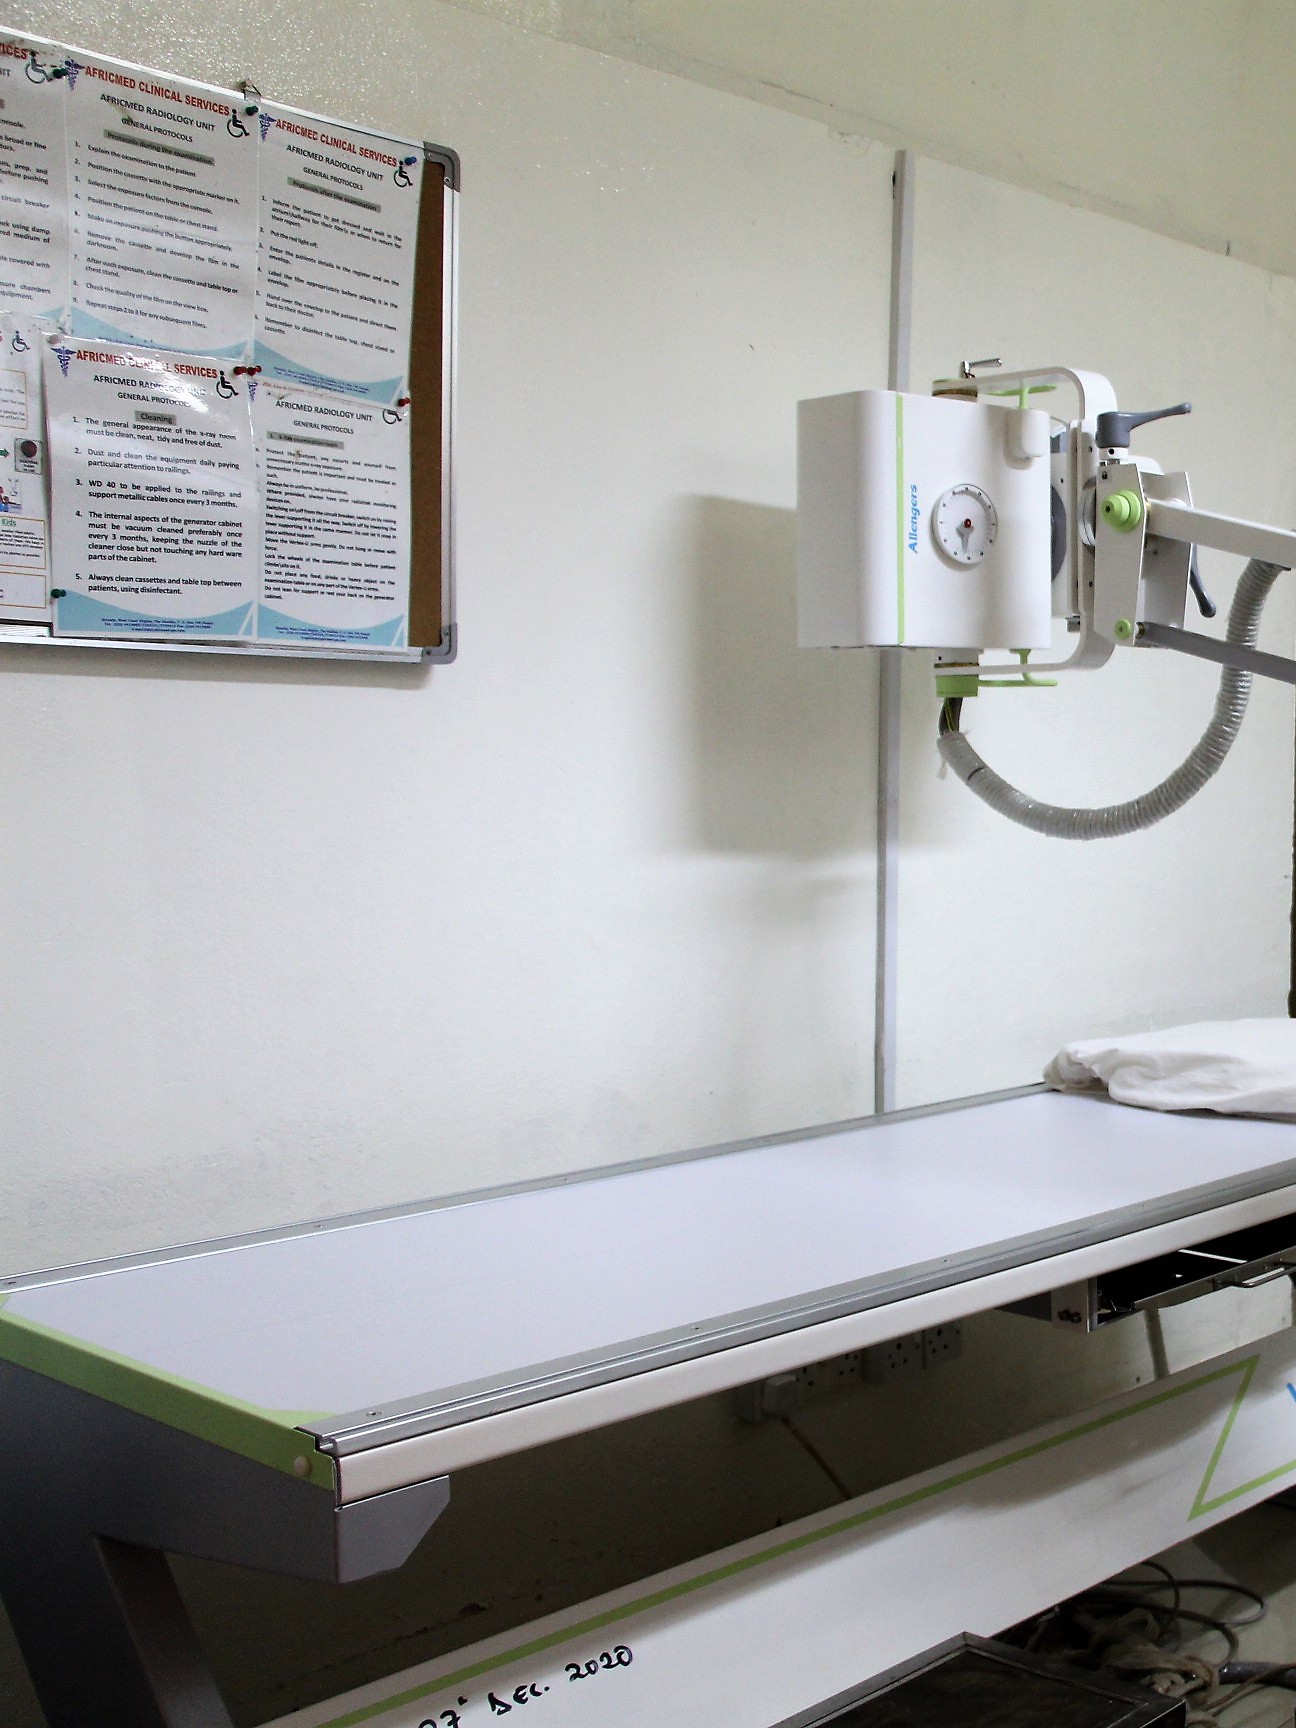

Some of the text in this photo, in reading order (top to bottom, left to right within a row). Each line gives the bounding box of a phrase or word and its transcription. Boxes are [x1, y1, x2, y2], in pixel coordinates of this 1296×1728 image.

[85, 66, 229, 116] AFRICMED CLINICAL SERVICES
[101, 94, 215, 131] AFRICMED RADIOLOGY UNIT
[122, 118, 192, 142] GENERAL PROTOCOLS
[276, 119, 397, 167] AFRICMED CLINICAL SERVICES
[287, 144, 383, 181] AFRICMED RADIOLOGY UNIT
[303, 167, 363, 190] GENERAL PROTOCOLS
[77, 350, 125, 366] AFRICMED
[174, 364, 217, 379] SERVICES
[94, 375, 136, 387] AFRICMED
[118, 392, 150, 402] GENERAL
[276, 400, 372, 421] AFRICMED RADIOLOGY UNIT
[141, 413, 173, 425] Cleaning
[86, 417, 99, 425] The
[103, 421, 129, 429] general
[133, 424, 172, 433] appearance
[200, 431, 216, 439] x-ray
[294, 420, 354, 434] GENERAL PROTOCOLS
[116, 431, 136, 440] clean,
[137, 434, 154, 442] neat,
[157, 435, 170, 443] tidy
[88, 448, 104, 456] Dust
[124, 452, 142, 460] clean
[160, 456, 197, 464] equipment
[200, 459, 215, 468] daily
[218, 462, 239, 470] paying
[88, 460, 122, 468] particular
[123, 463, 155, 471] attention
[165, 466, 191, 475] railings.
[145, 485, 170, 493] applied
[202, 489, 225, 498] railings
[104, 512, 132, 520] internal
[908, 483, 920, 554] Allengers
[157, 526, 183, 534] cleaned
[188, 528, 222, 537] preferably
[88, 533, 108, 541] every
[120, 535, 148, 543] months,
[152, 536, 179, 545] keeping
[88, 542, 115, 550] cleaner
[164, 547, 193, 556] touching
[129, 555, 157, 563] cabinet.
[89, 574, 114, 582] Always
[200, 579, 212, 587] top
[213, 579, 241, 587] between
[121, 586, 139, 594] using
[140, 586, 182, 594] disinfectant.
[564, 1645, 633, 1682] 2020
